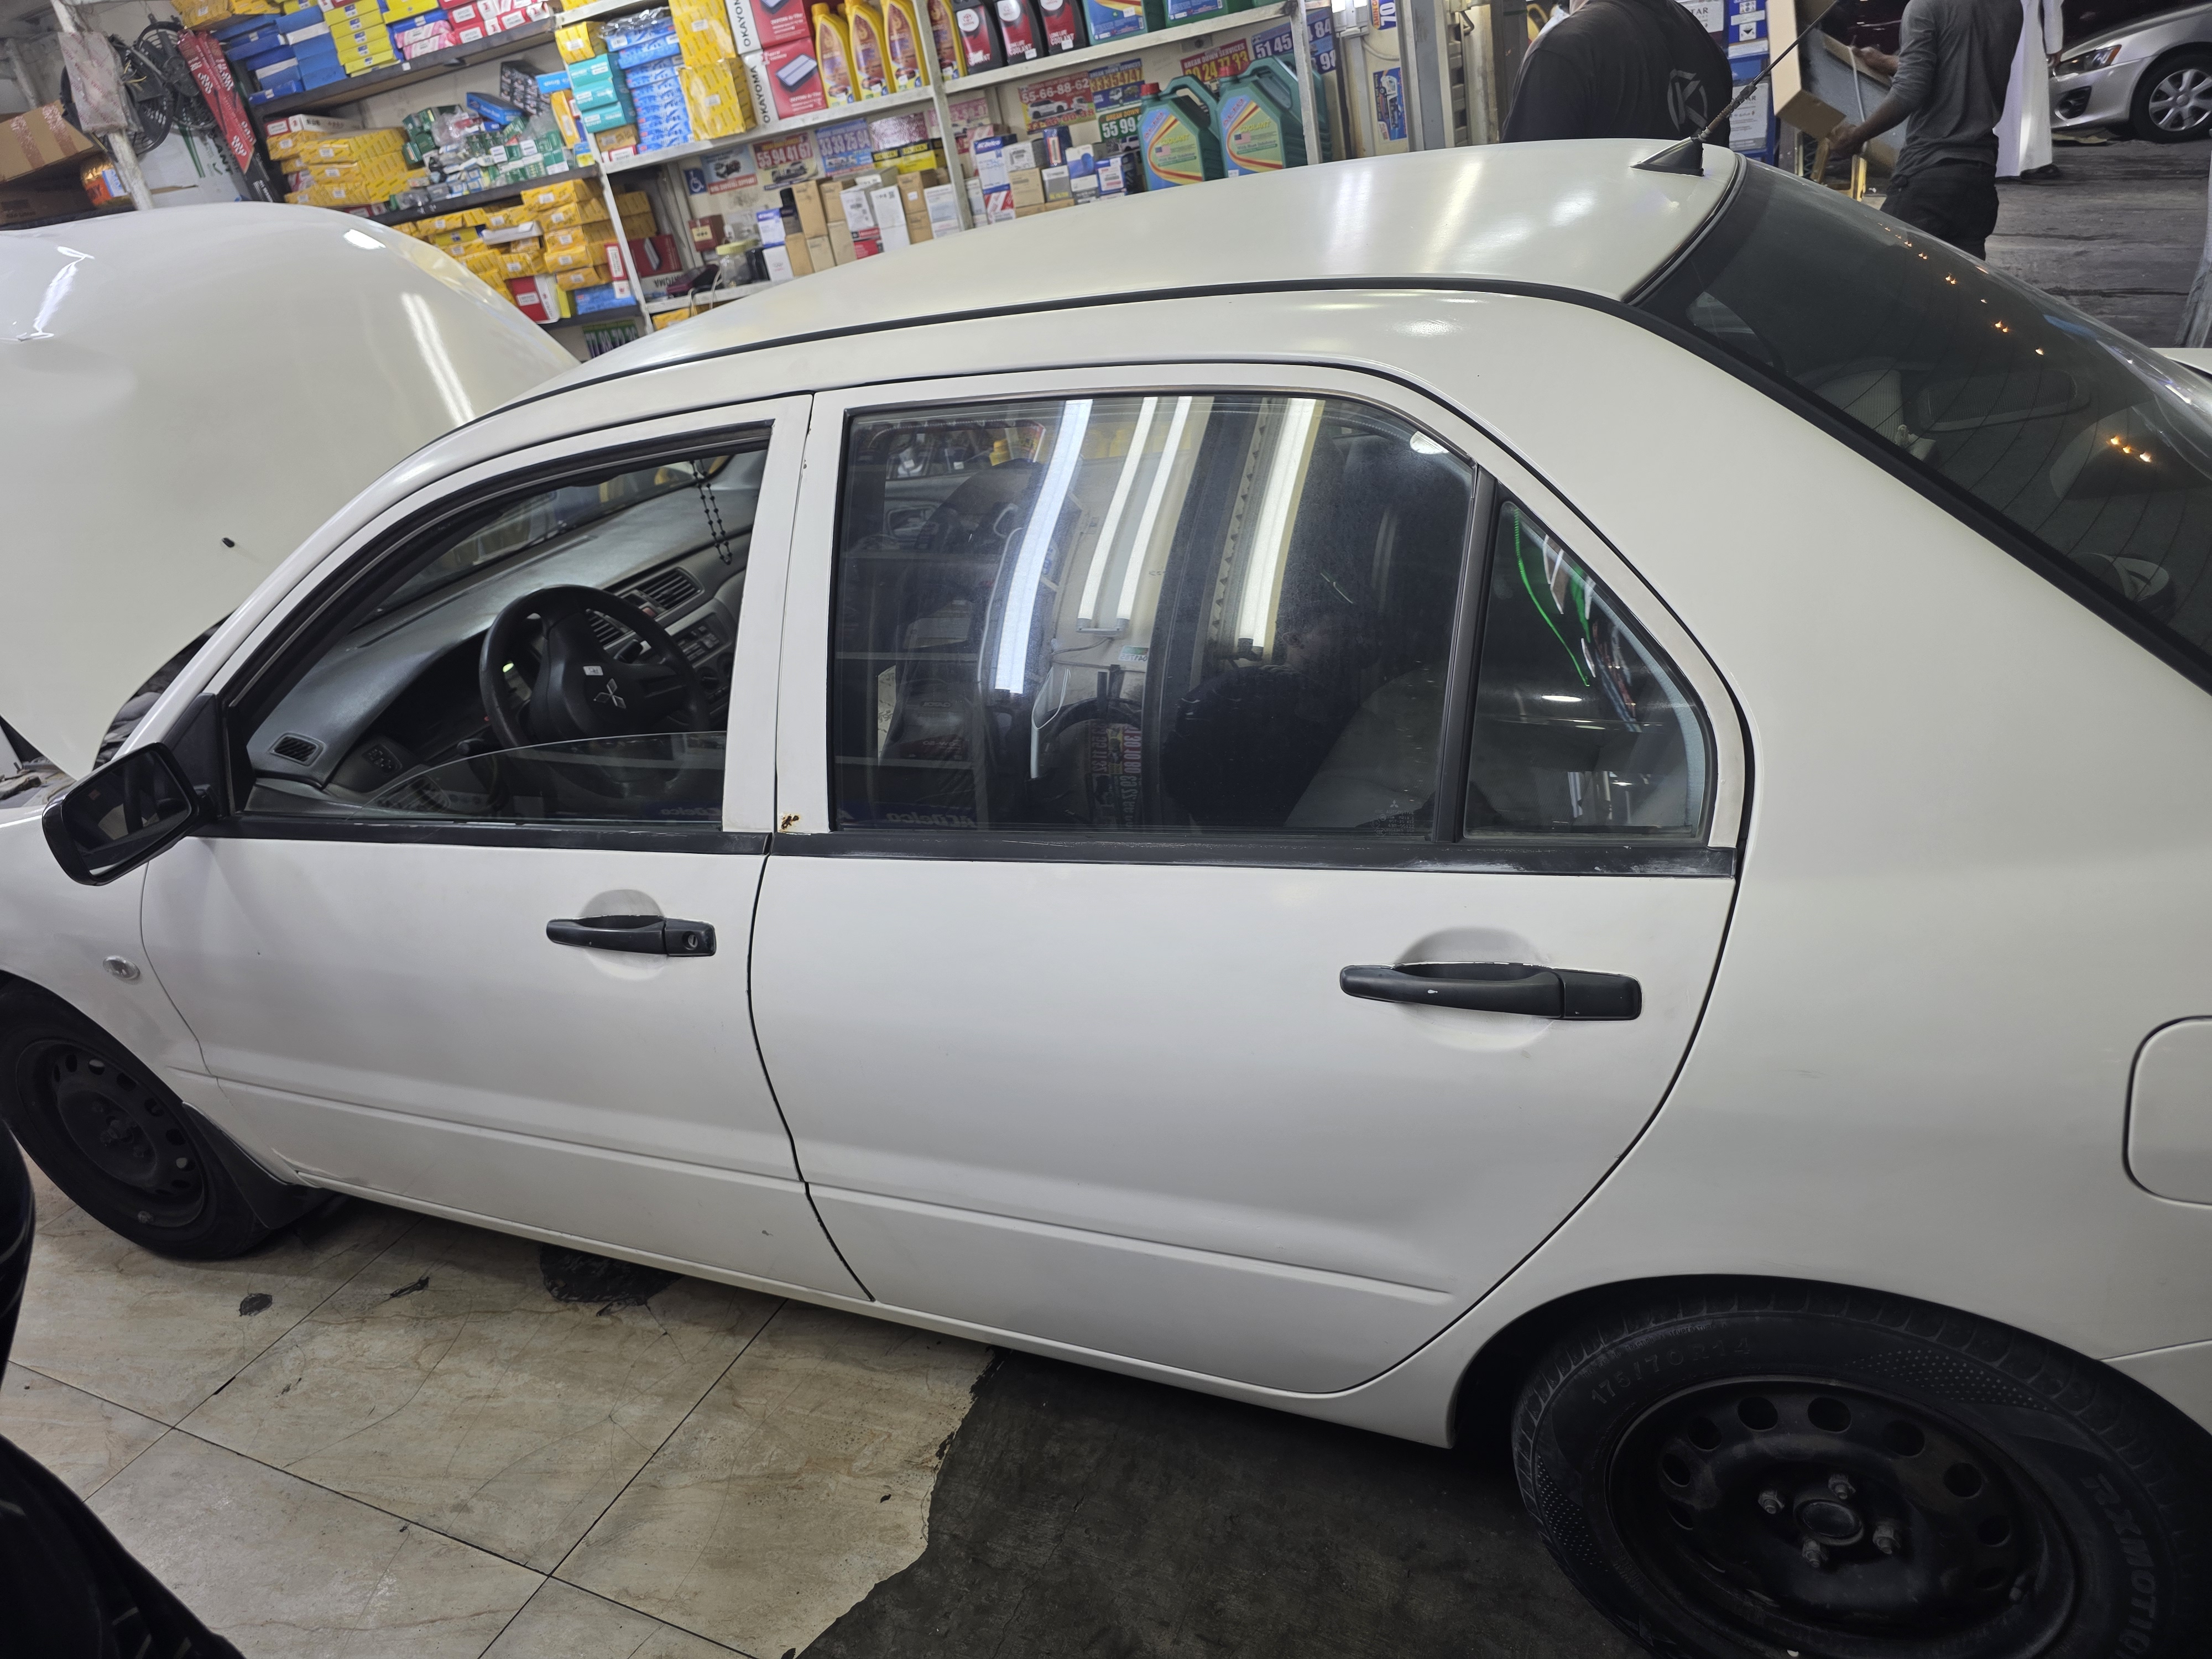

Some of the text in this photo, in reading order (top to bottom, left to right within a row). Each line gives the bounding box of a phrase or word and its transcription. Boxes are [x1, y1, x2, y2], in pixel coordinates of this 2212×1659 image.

[734, 0, 751, 46] OKAYO
[1379, 2, 1396, 26] 70
[1274, 34, 1292, 53] 45
[750, 65, 771, 123] OKAYOMA
[1144, 111, 1164, 139] ALTO
[1223, 98, 1244, 127] ALTO
[1102, 117, 1135, 138] 55 99
[1239, 120, 1271, 133] COOLANT
[757, 150, 772, 167] 55
[771, 148, 786, 165] 94
[1626, 1337, 1655, 1351] TRACTION
[1670, 1324, 1714, 1337] TEMPERATURE
